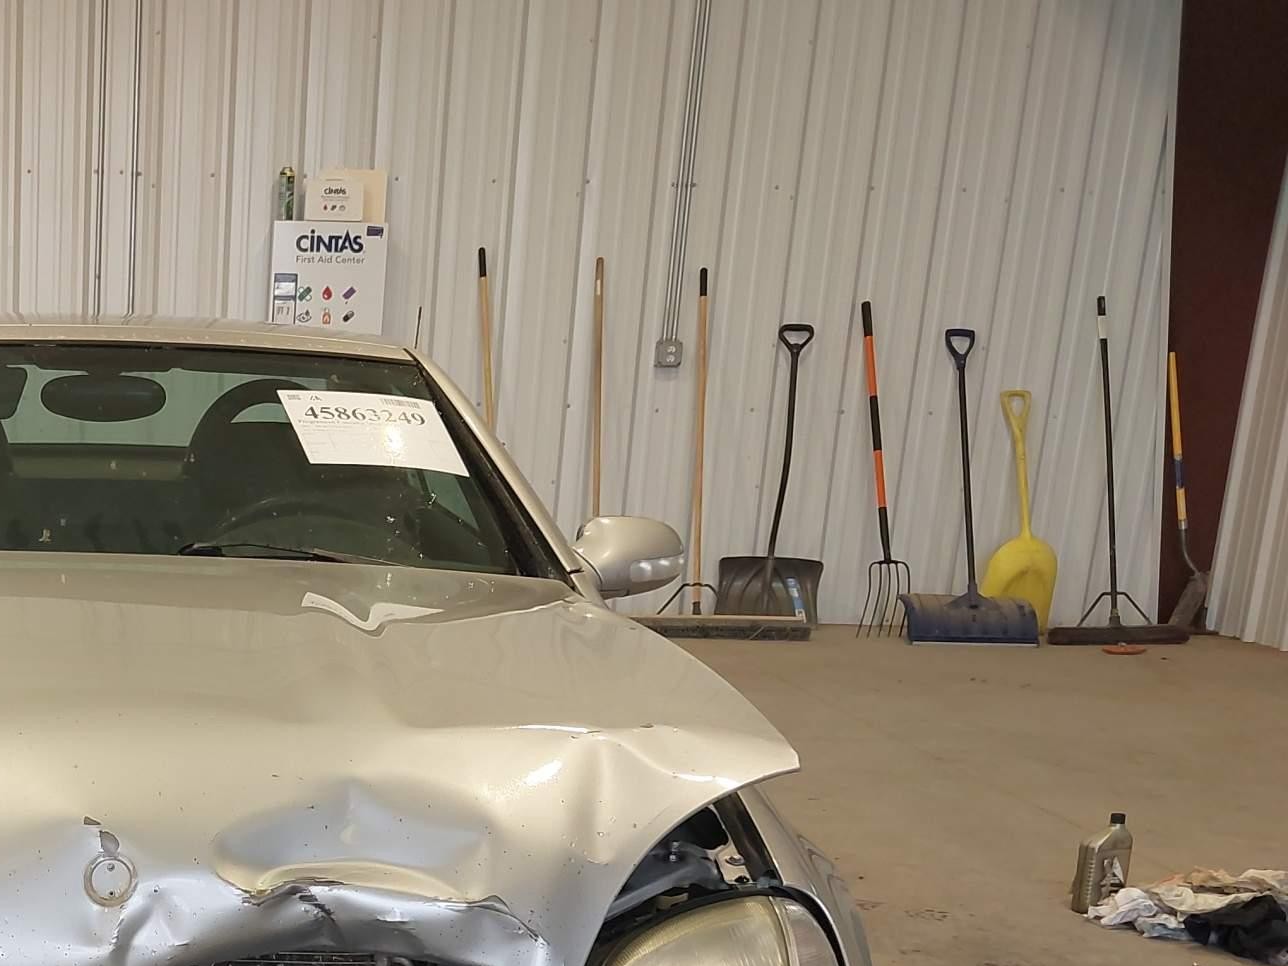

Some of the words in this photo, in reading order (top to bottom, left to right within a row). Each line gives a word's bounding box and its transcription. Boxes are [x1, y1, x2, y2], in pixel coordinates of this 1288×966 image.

[296, 256, 315, 264] First
[317, 256, 332, 264] Aid
[335, 256, 365, 264] Center
[304, 406, 426, 426] 45863249
